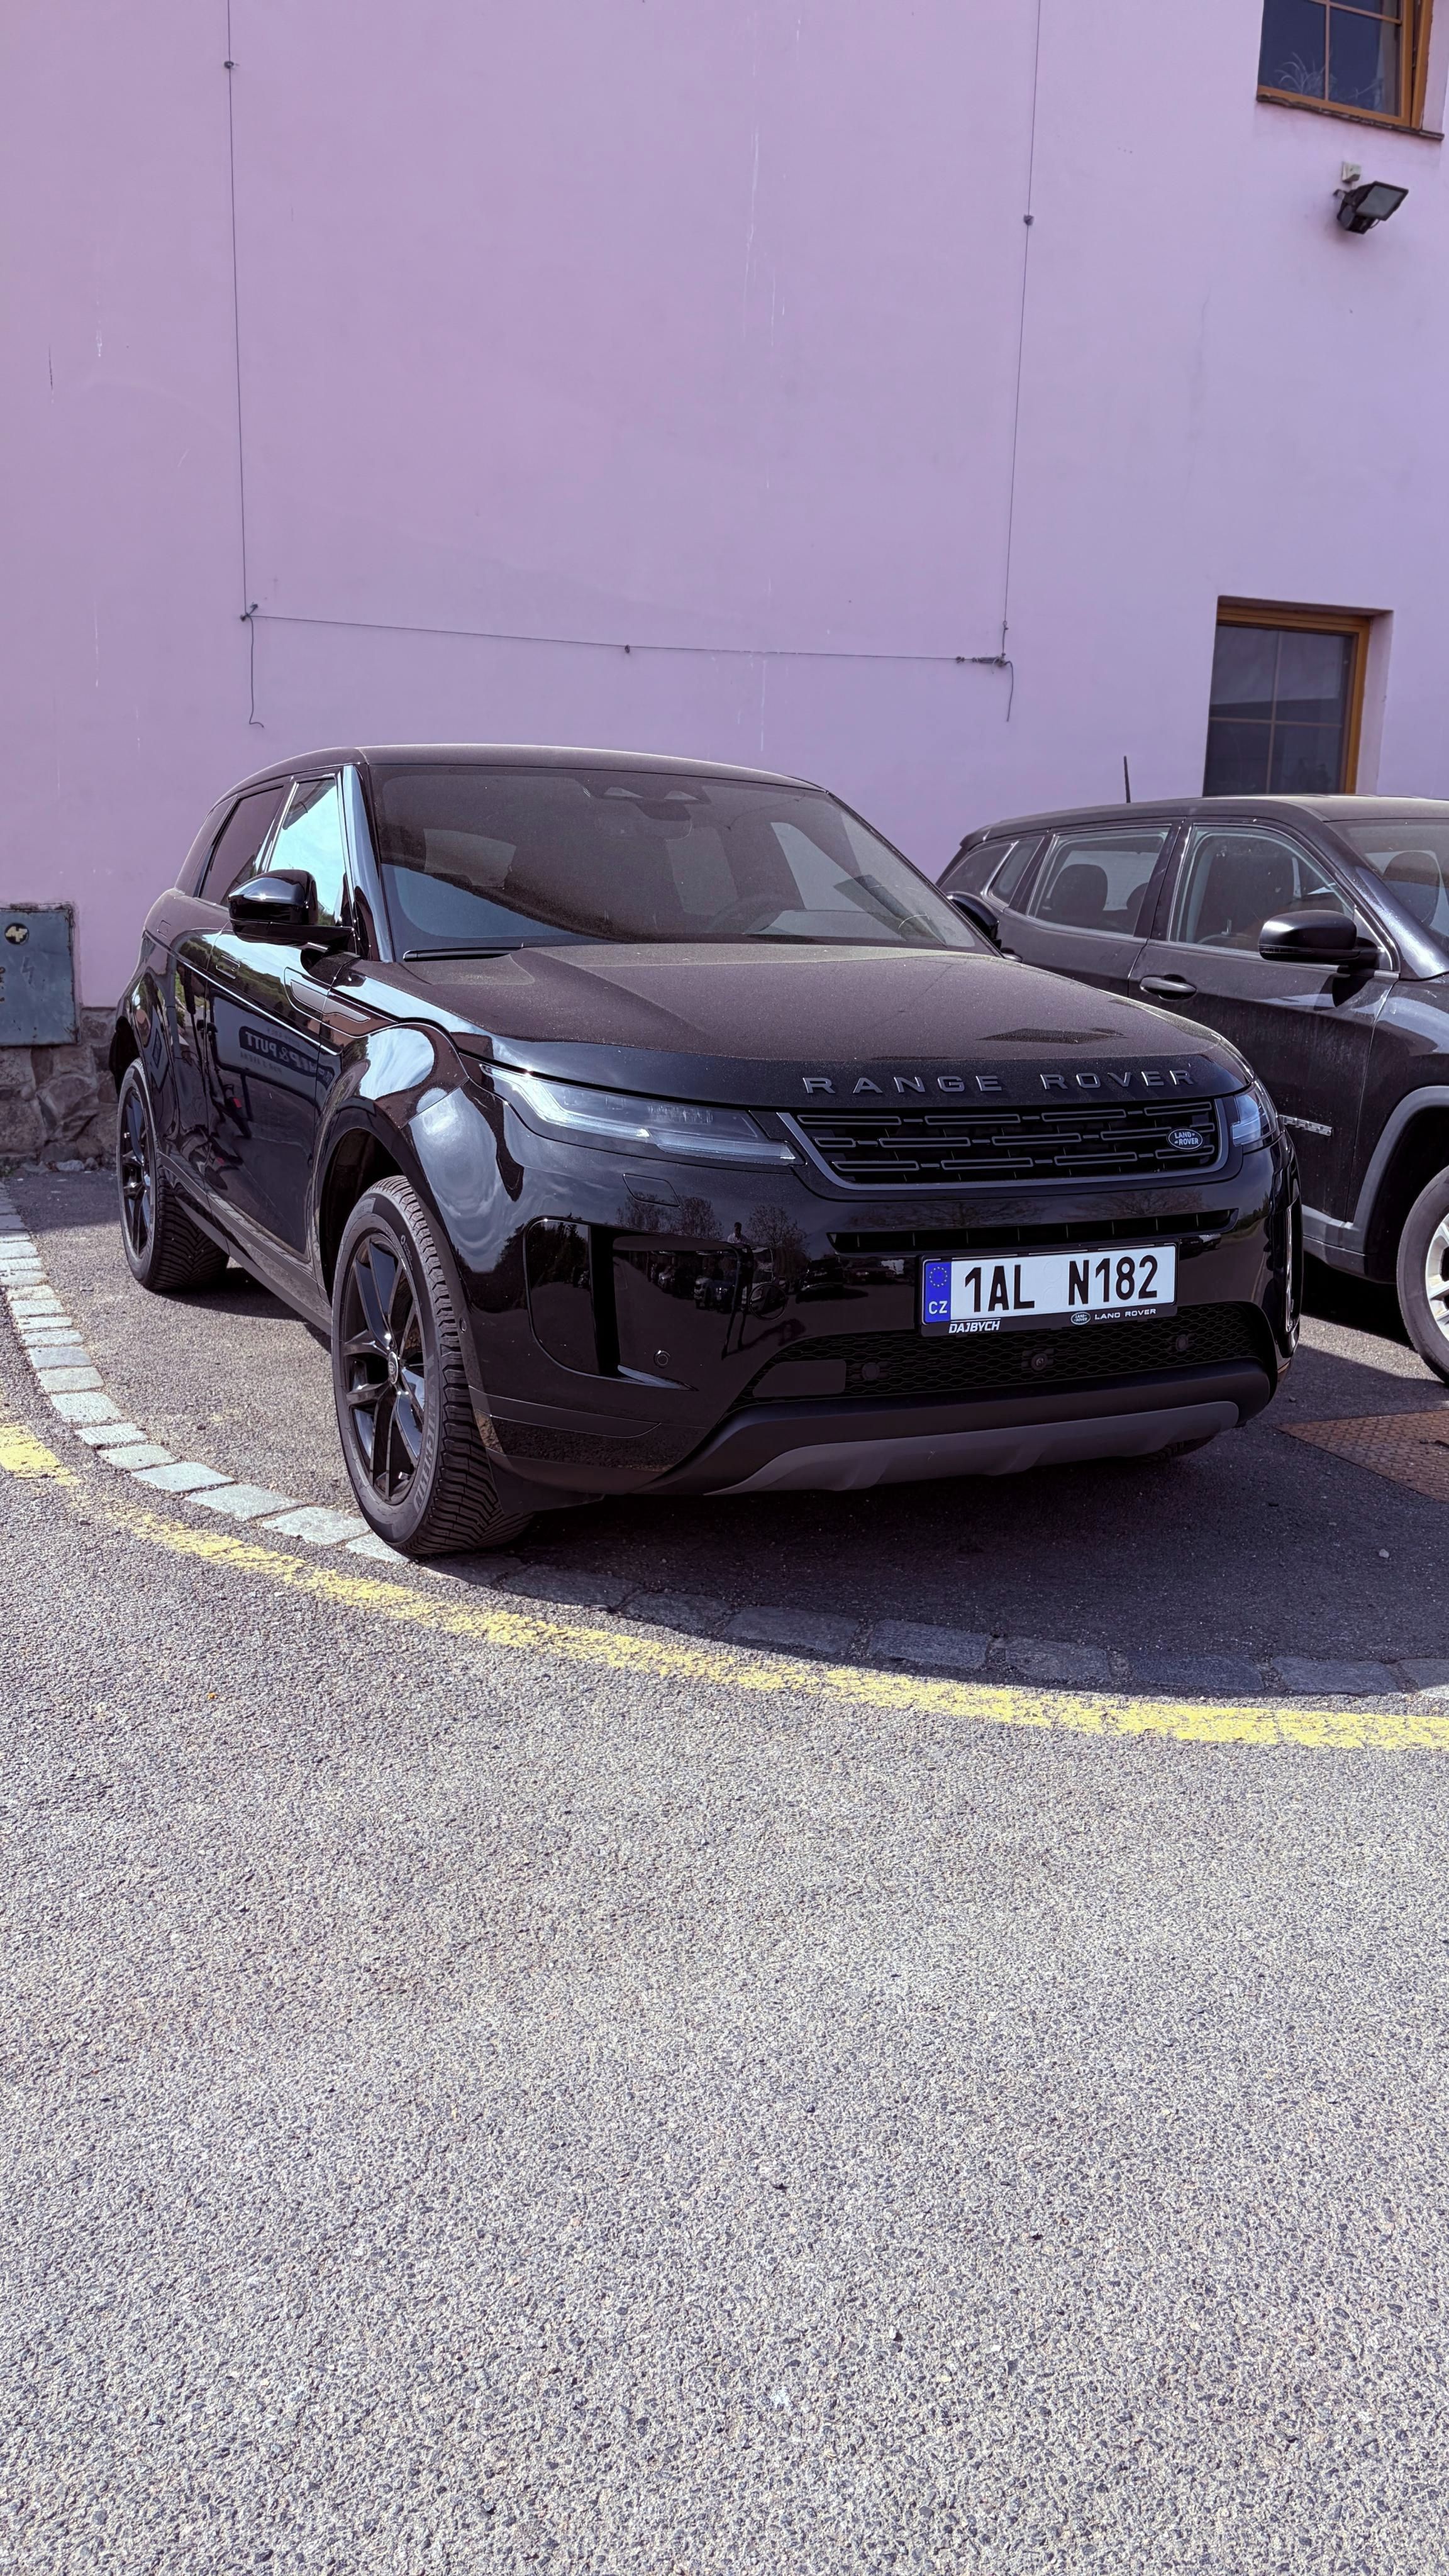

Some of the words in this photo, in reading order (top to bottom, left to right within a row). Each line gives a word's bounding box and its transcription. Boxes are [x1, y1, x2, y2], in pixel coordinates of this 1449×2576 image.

[802, 1075, 1003, 1094] RANGE
[1040, 1070, 1194, 1090] ROVER
[1278, 1114, 1332, 1136] PASS
[1179, 1138, 1199, 1146] ROVER
[965, 1265, 1035, 1313] 1AL
[1069, 1255, 1158, 1306] N182
[928, 1300, 948, 1314] CZ
[1094, 1312, 1121, 1320] LAND
[1124, 1309, 1157, 1318] ROVER
[948, 1320, 1001, 1333] DAJBYCH
[414, 1402, 436, 1508] MICHELIN
